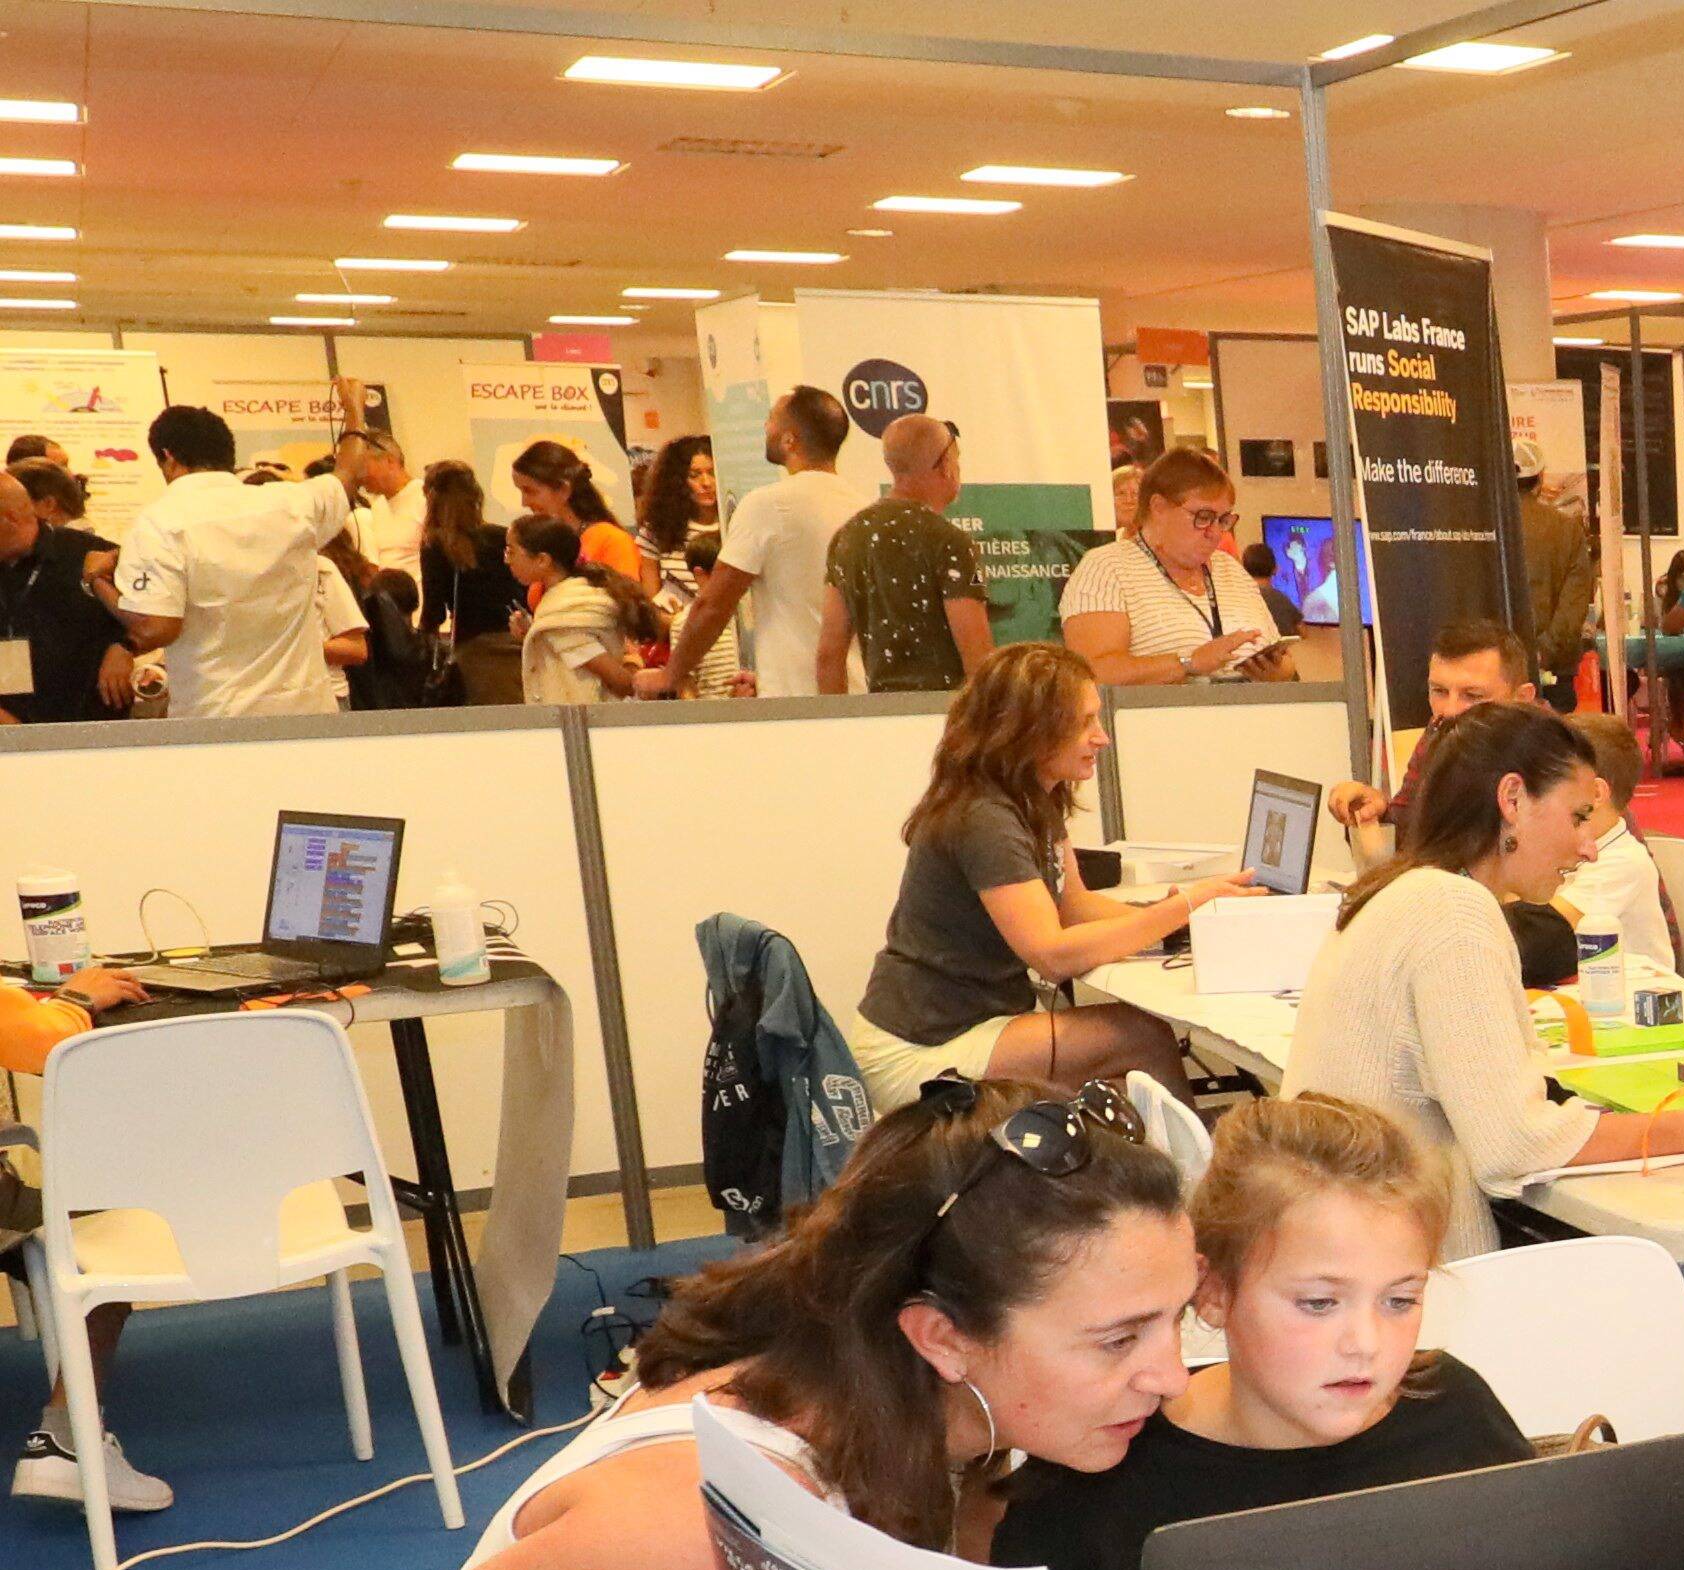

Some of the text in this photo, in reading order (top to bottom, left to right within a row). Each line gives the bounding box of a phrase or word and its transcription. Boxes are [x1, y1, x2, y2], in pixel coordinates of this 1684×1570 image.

[1345, 306, 1466, 350] SAP Labs France
[1349, 348, 1436, 380] runs Social
[223, 399, 297, 414] ESCAPE
[471, 382, 589, 401] ESCAPE BOX
[851, 380, 921, 410] cnrs
[1352, 382, 1457, 424] Responsibility
[1360, 456, 1478, 486] Make the difference.
